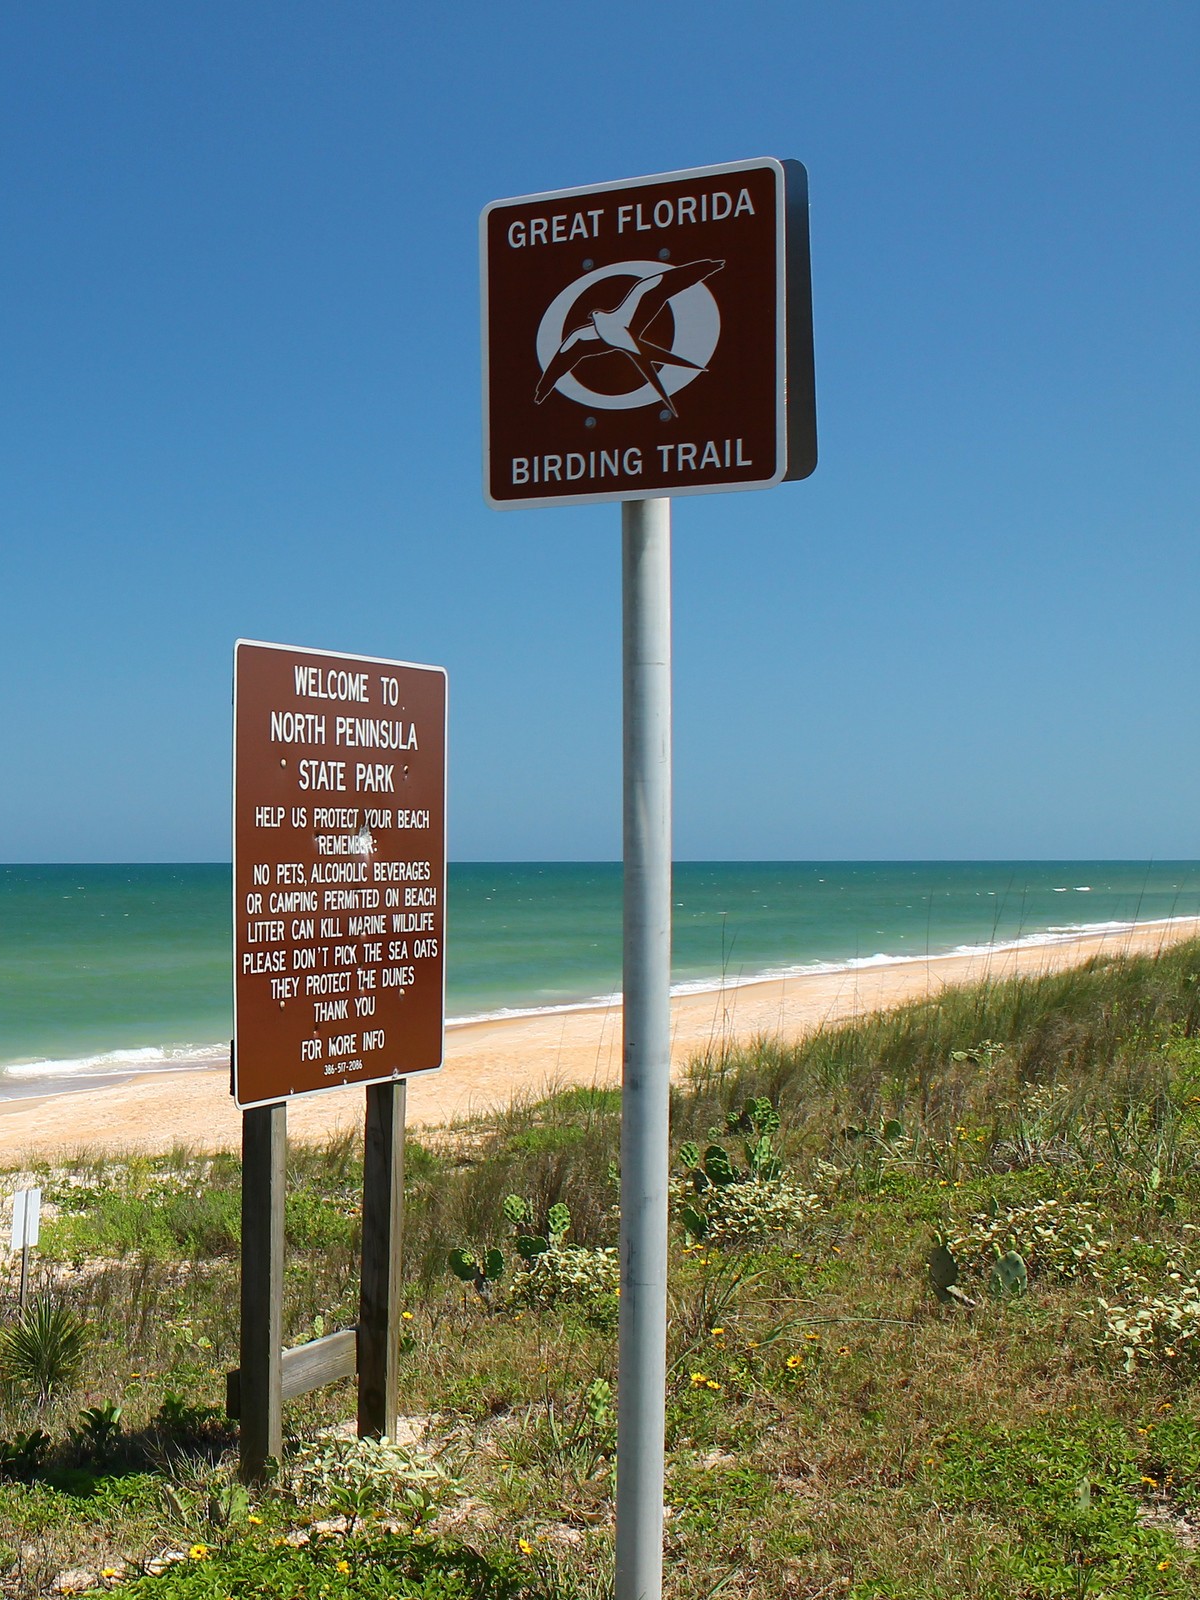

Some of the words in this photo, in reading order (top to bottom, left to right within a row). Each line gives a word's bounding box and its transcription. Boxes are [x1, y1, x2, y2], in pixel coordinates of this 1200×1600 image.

[508, 209, 604, 248] GREAT
[617, 188, 755, 233] FLORIDA
[512, 448, 643, 485] BIRDING
[657, 439, 752, 472] TRAIL
[295, 666, 369, 702] WELCOME
[381, 677, 399, 706] TO
[271, 711, 325, 744] NORTH
[336, 717, 418, 750] PENINSULA
[299, 759, 346, 791] STATE
[356, 764, 394, 792] PARK
[256, 807, 285, 827] HELP
[292, 808, 307, 828] US
[314, 808, 358, 828] PROTECT
[364, 809, 392, 828] YOUR
[397, 810, 429, 828] BEACH
[254, 864, 270, 885] NO
[277, 864, 307, 886] PETS,
[311, 863, 367, 883] ALCOHOLIC
[374, 862, 430, 881] BEVERAGES
[247, 893, 262, 914] OR
[270, 892, 318, 913] CAMPING
[324, 889, 379, 910] PERMITTED
[386, 888, 399, 907] ON
[405, 888, 437, 906] BEACH
[248, 921, 284, 942] LITTER
[292, 919, 314, 940] CAN
[321, 918, 342, 938] KILL
[349, 915, 386, 936] MARINE
[393, 913, 434, 933] WILDLIFE
[243, 951, 286, 974] PLEASE
[293, 947, 328, 970] DON'T
[335, 945, 357, 965] PICK
[364, 943, 382, 963] THE
[389, 941, 407, 960] SEA
[414, 939, 437, 958] OATS
[271, 977, 299, 999] THEY
[307, 972, 351, 996] PROTECT
[357, 968, 376, 990] THE
[382, 966, 414, 987] DUNES
[314, 1000, 348, 1022] THANK
[355, 996, 375, 1017] YOU
[302, 1039, 322, 1061] FOR
[329, 1034, 356, 1056] MORE
[363, 1030, 385, 1051] INFO
[324, 1060, 363, 1075] 386-517-2086
